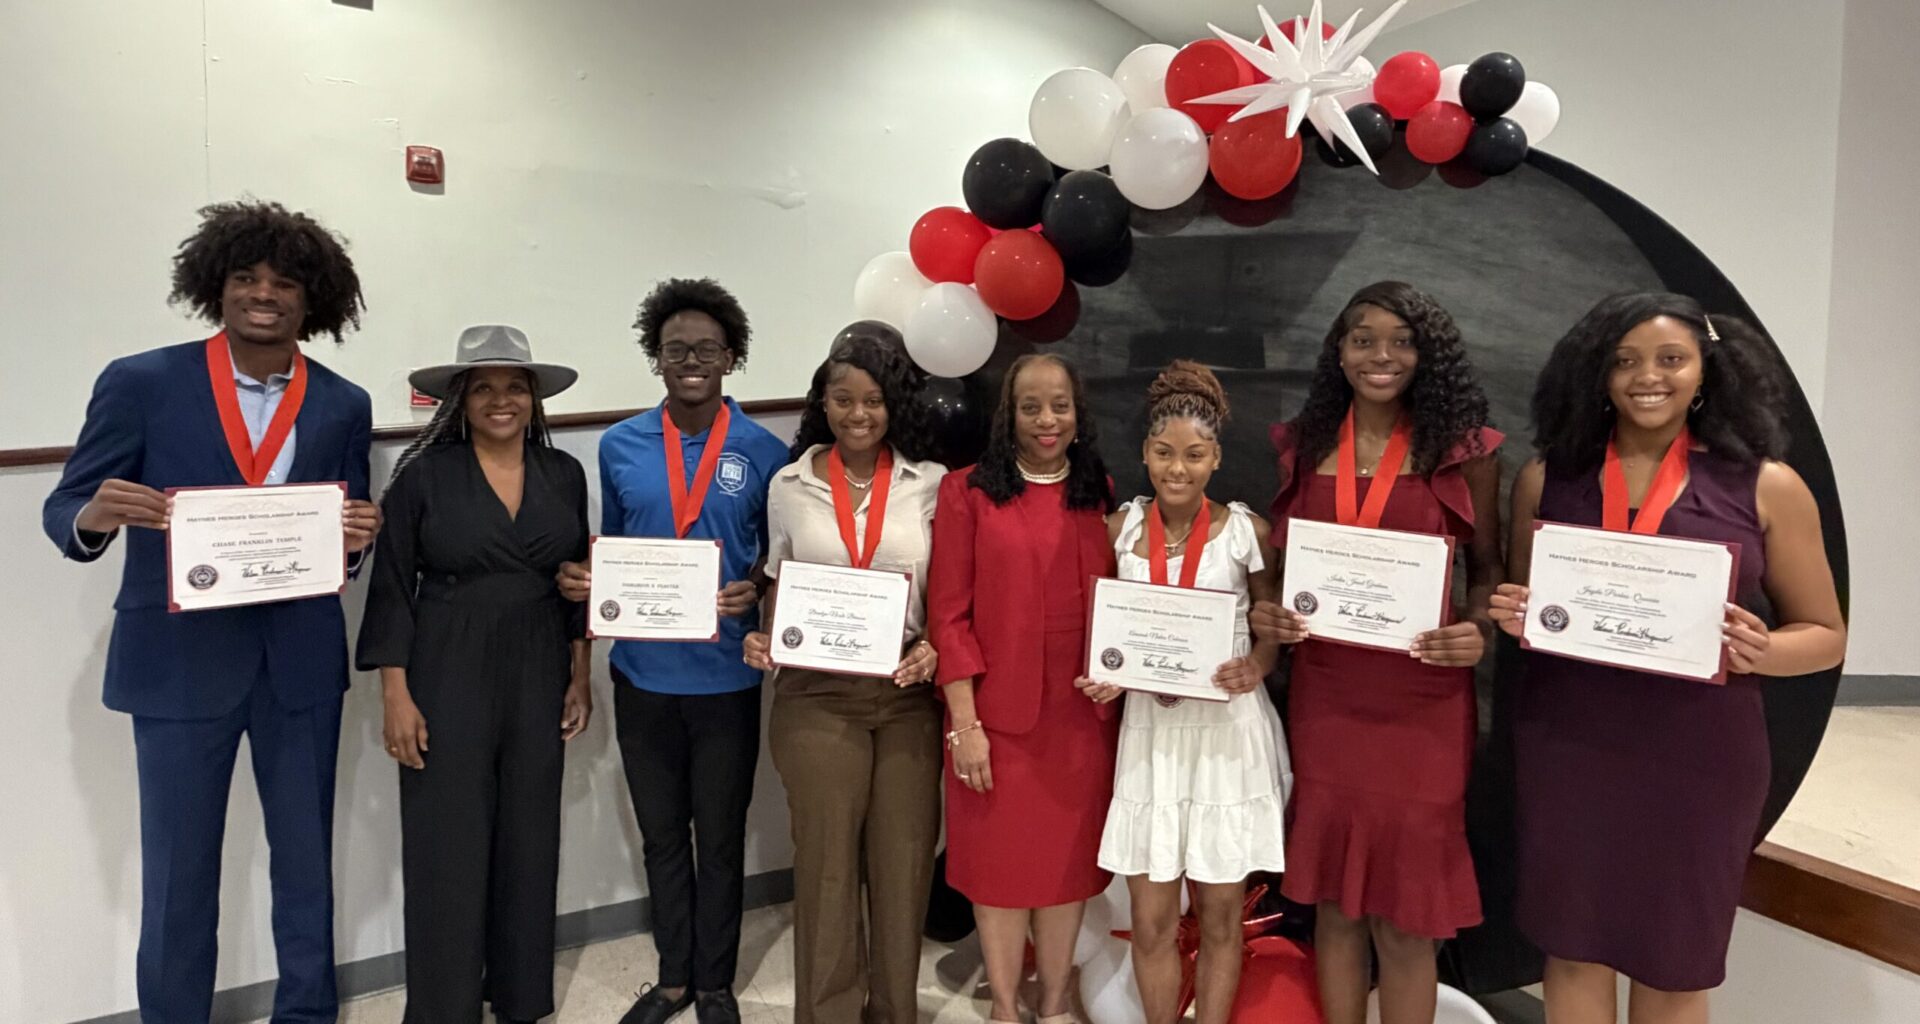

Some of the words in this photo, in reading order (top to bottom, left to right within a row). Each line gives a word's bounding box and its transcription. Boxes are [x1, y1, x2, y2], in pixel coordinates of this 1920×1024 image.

[1549, 553, 1577, 563] HAYNES
[1579, 558, 1608, 567] HEROES
[1611, 561, 1665, 574] SCHOLARSHIP
[1667, 570, 1696, 579] AWARD
